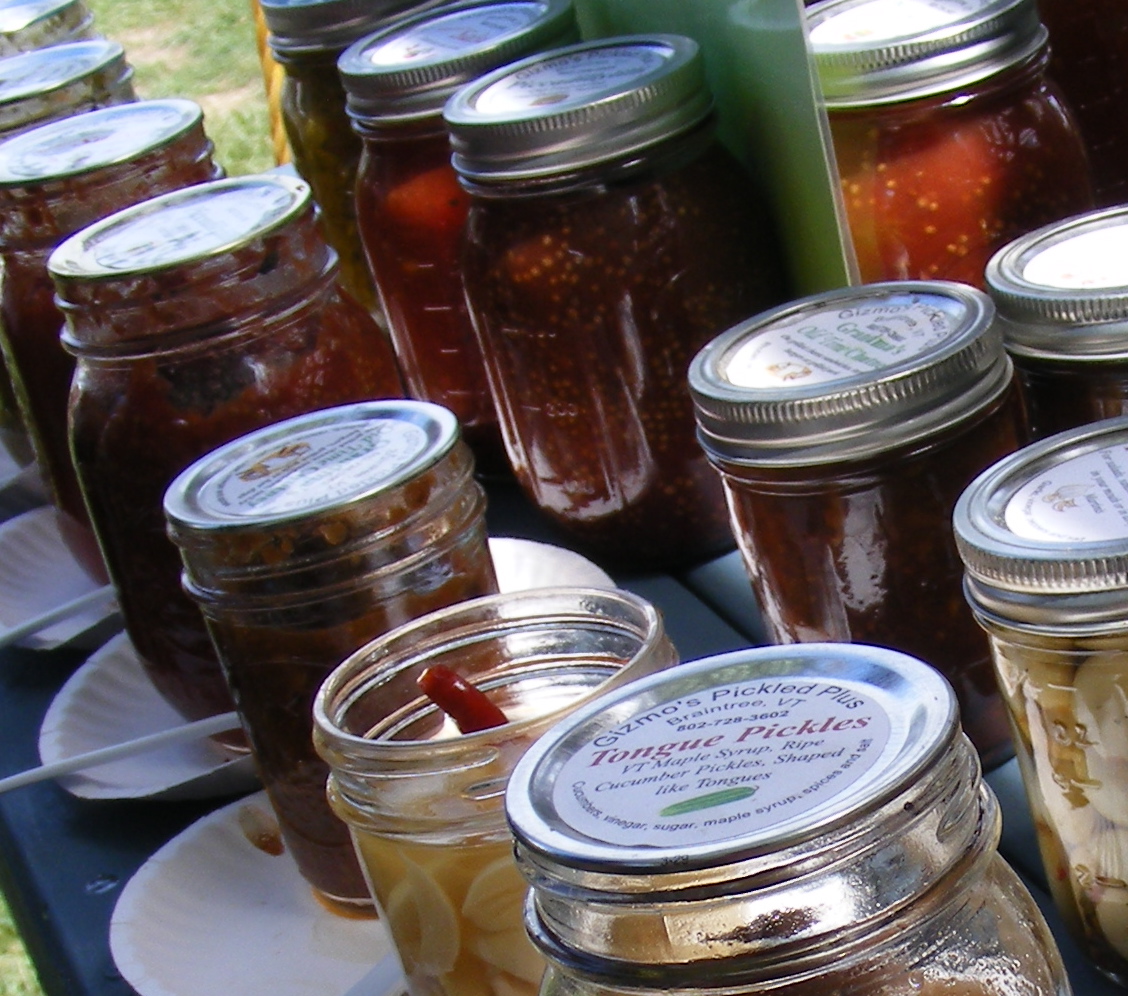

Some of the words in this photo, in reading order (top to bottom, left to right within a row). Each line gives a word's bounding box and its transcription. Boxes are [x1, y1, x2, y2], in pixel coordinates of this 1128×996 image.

[592, 698, 703, 748] Gizmo's
[711, 682, 818, 702] Pickled
[820, 684, 865, 711] Plus
[676, 709, 790, 732] 802-728-3602
[776, 697, 807, 709] VT
[588, 731, 725, 768] Tongue
[734, 714, 873, 743] Pickles
[621, 760, 654, 775] VT
[650, 750, 715, 773] Maple
[782, 738, 826, 755] Ripe
[594, 768, 688, 793] Cucumber
[772, 746, 847, 768] Shaped
[654, 781, 692, 796] like
[697, 770, 773, 790] Tongues
[703, 810, 752, 828] maple
[803, 767, 844, 795] spices
